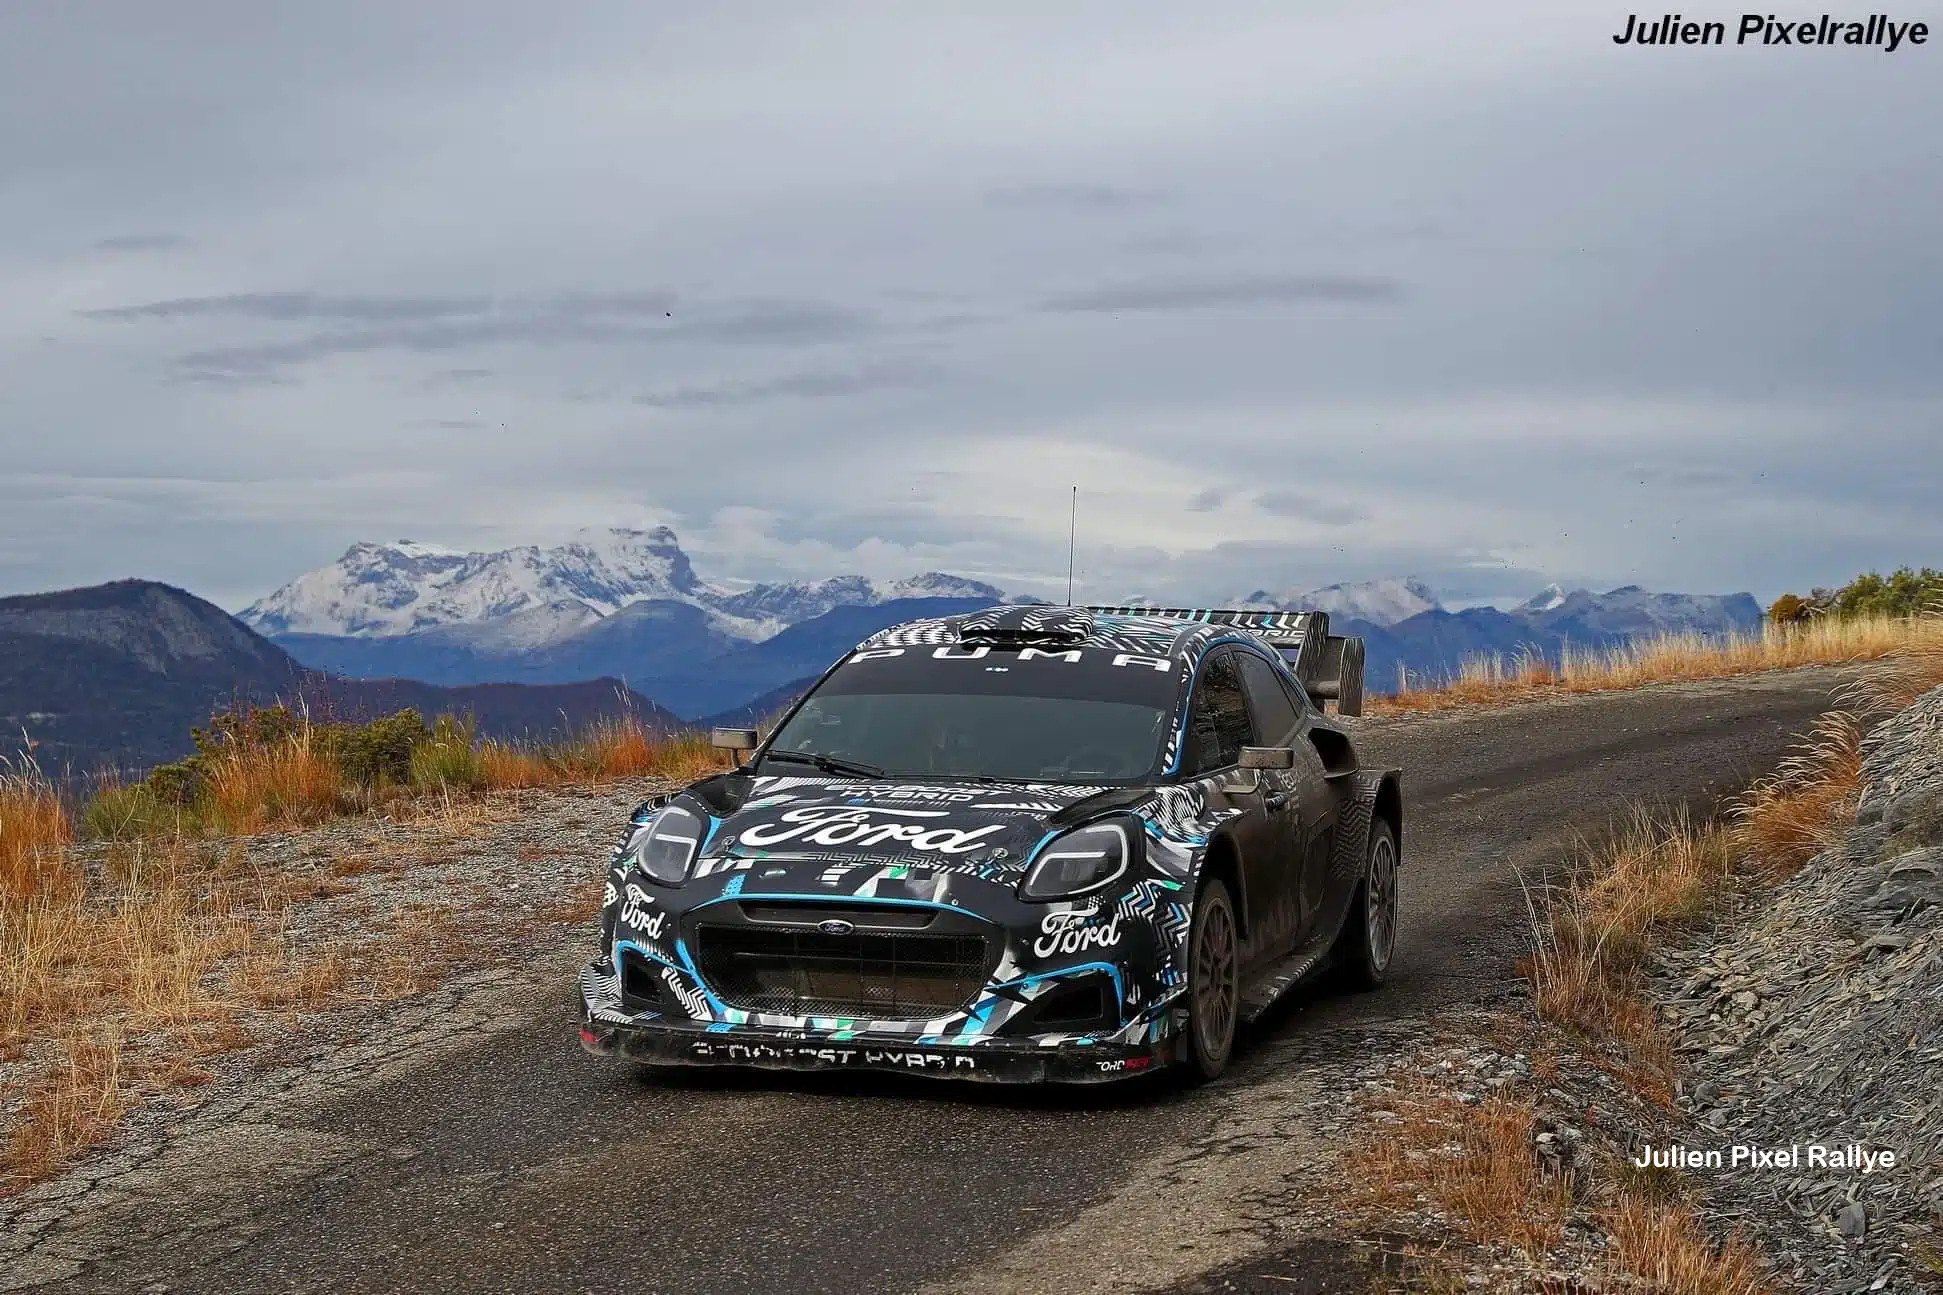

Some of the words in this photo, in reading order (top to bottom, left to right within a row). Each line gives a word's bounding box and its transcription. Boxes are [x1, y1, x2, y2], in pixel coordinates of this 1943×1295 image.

[848, 646, 1172, 673] PUMA
[840, 790, 975, 802] HYBRID
[739, 805, 1006, 854] Ford
[621, 882, 666, 940] Ford
[1033, 904, 1122, 959] Ford
